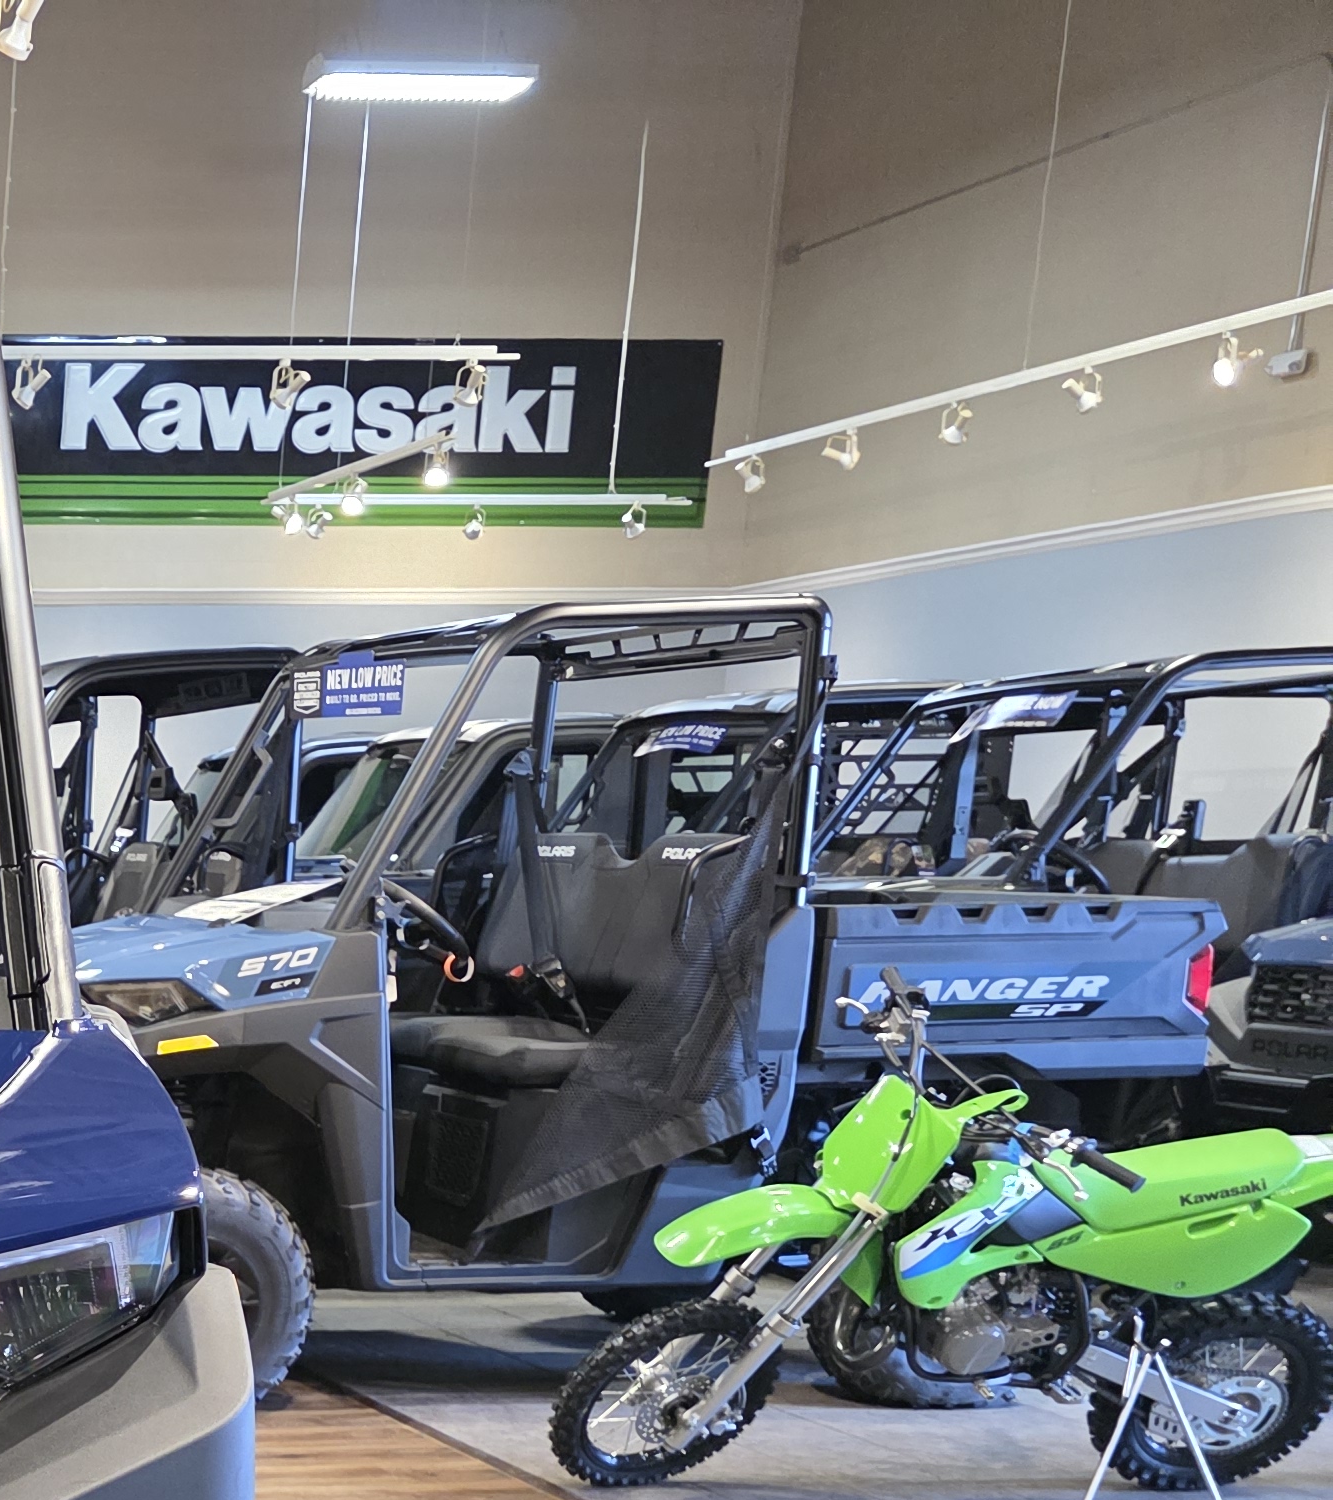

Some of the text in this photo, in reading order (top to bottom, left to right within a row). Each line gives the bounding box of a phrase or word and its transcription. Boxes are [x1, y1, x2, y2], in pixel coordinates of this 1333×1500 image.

[59, 362, 578, 455] Kawasaki
[326, 664, 404, 690] NEW LOW PRICE
[237, 946, 319, 978] 570
[1010, 1003, 1085, 1018] SP
[1179, 1177, 1268, 1207] Kawasaki
